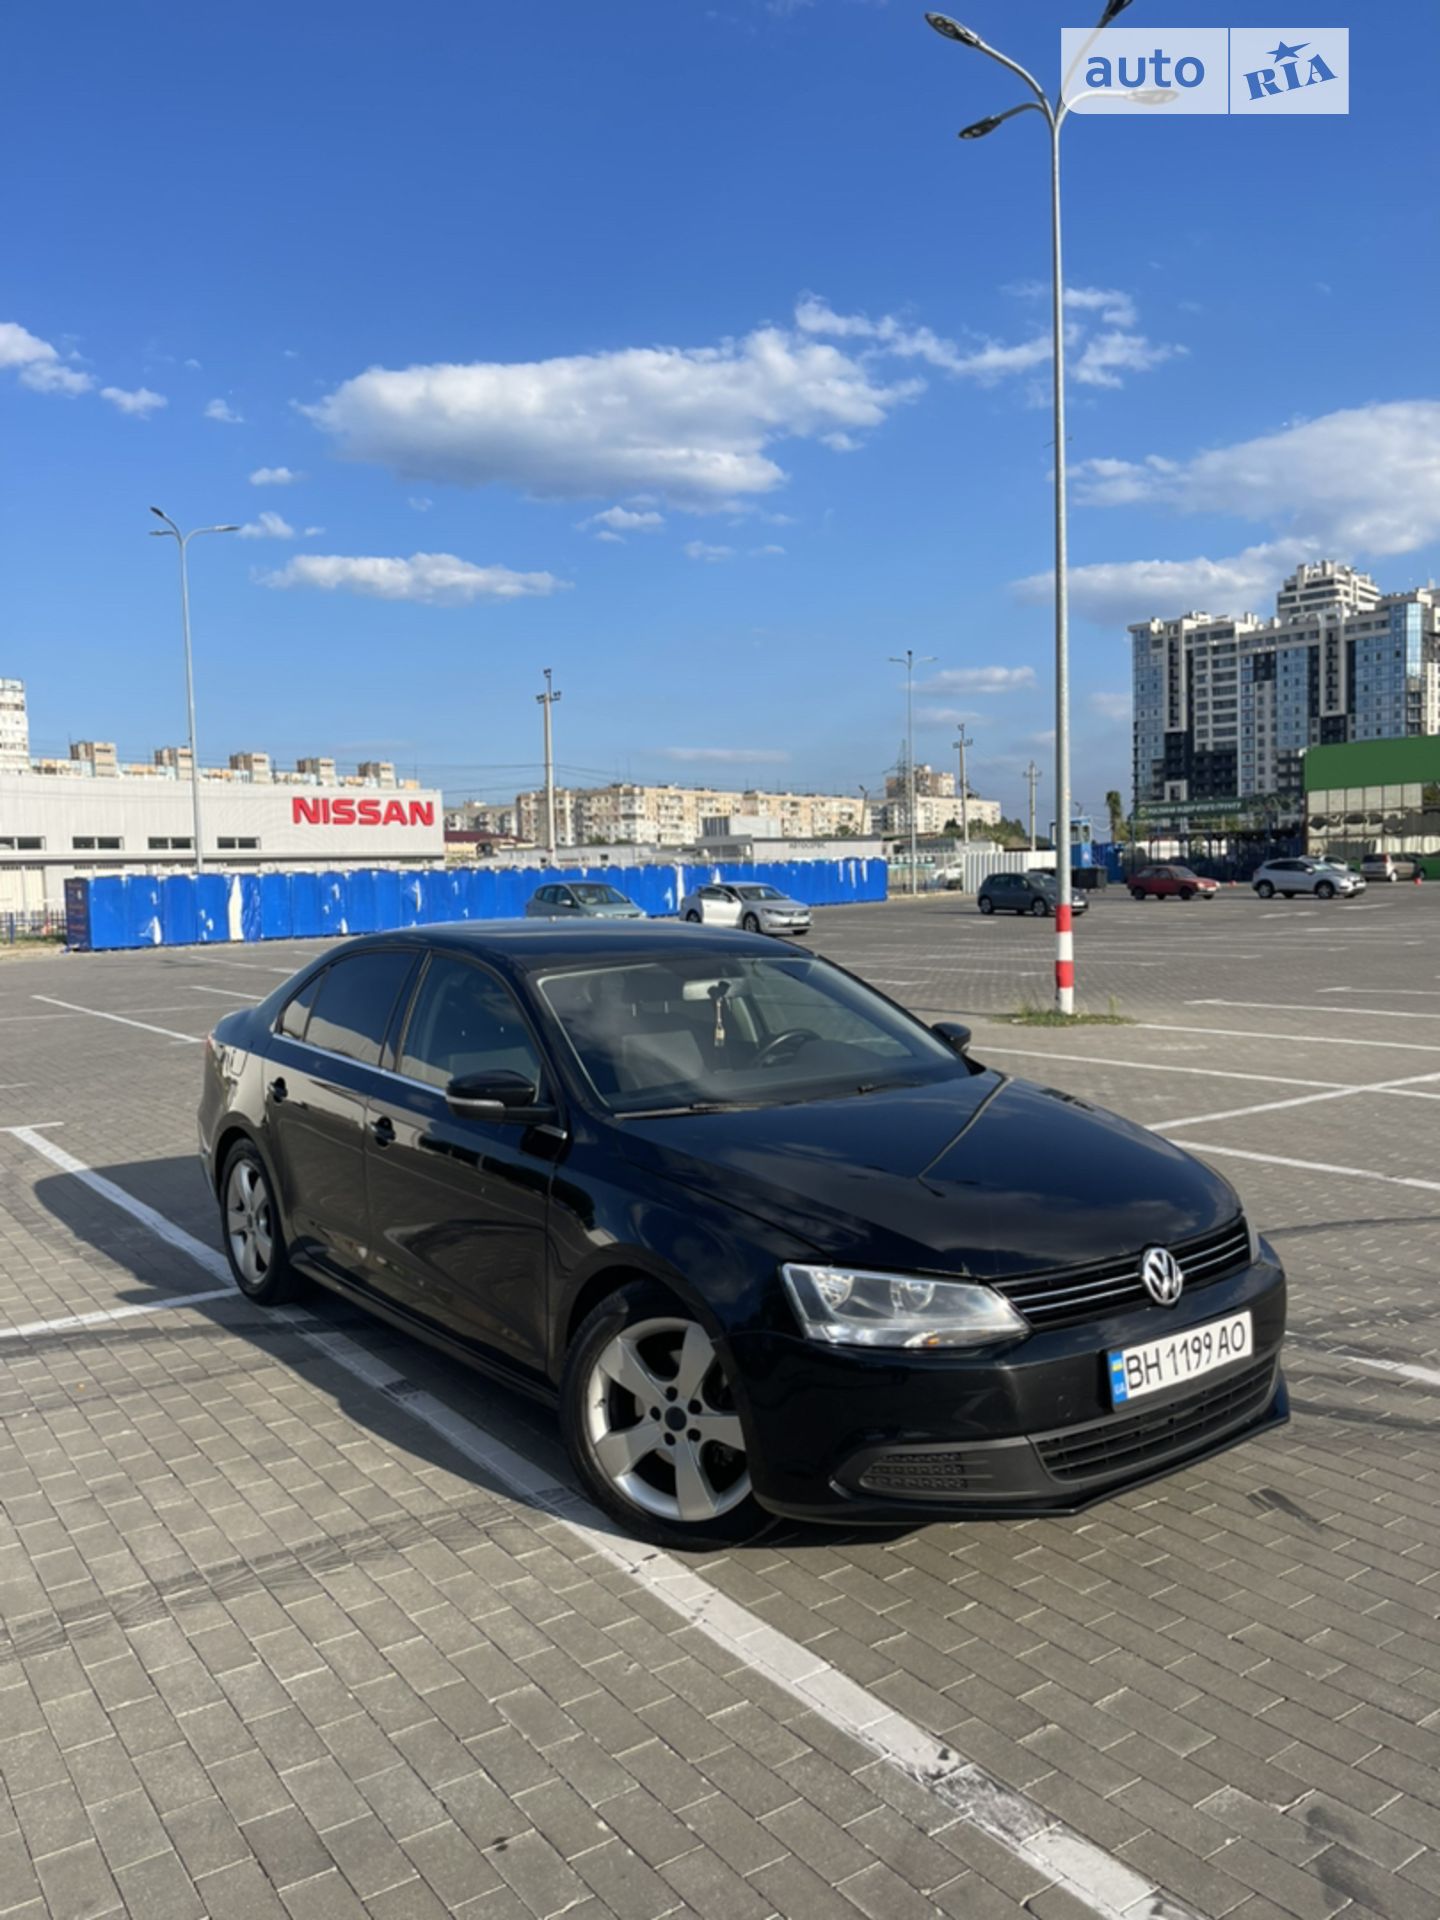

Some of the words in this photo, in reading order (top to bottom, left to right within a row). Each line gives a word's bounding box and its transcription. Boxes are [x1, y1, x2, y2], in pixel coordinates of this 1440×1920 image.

[292, 796, 435, 826] NISSAN
[1125, 1346, 1163, 1390] BH
[1166, 1331, 1213, 1377] 1199
[1217, 1320, 1246, 1359] AO
